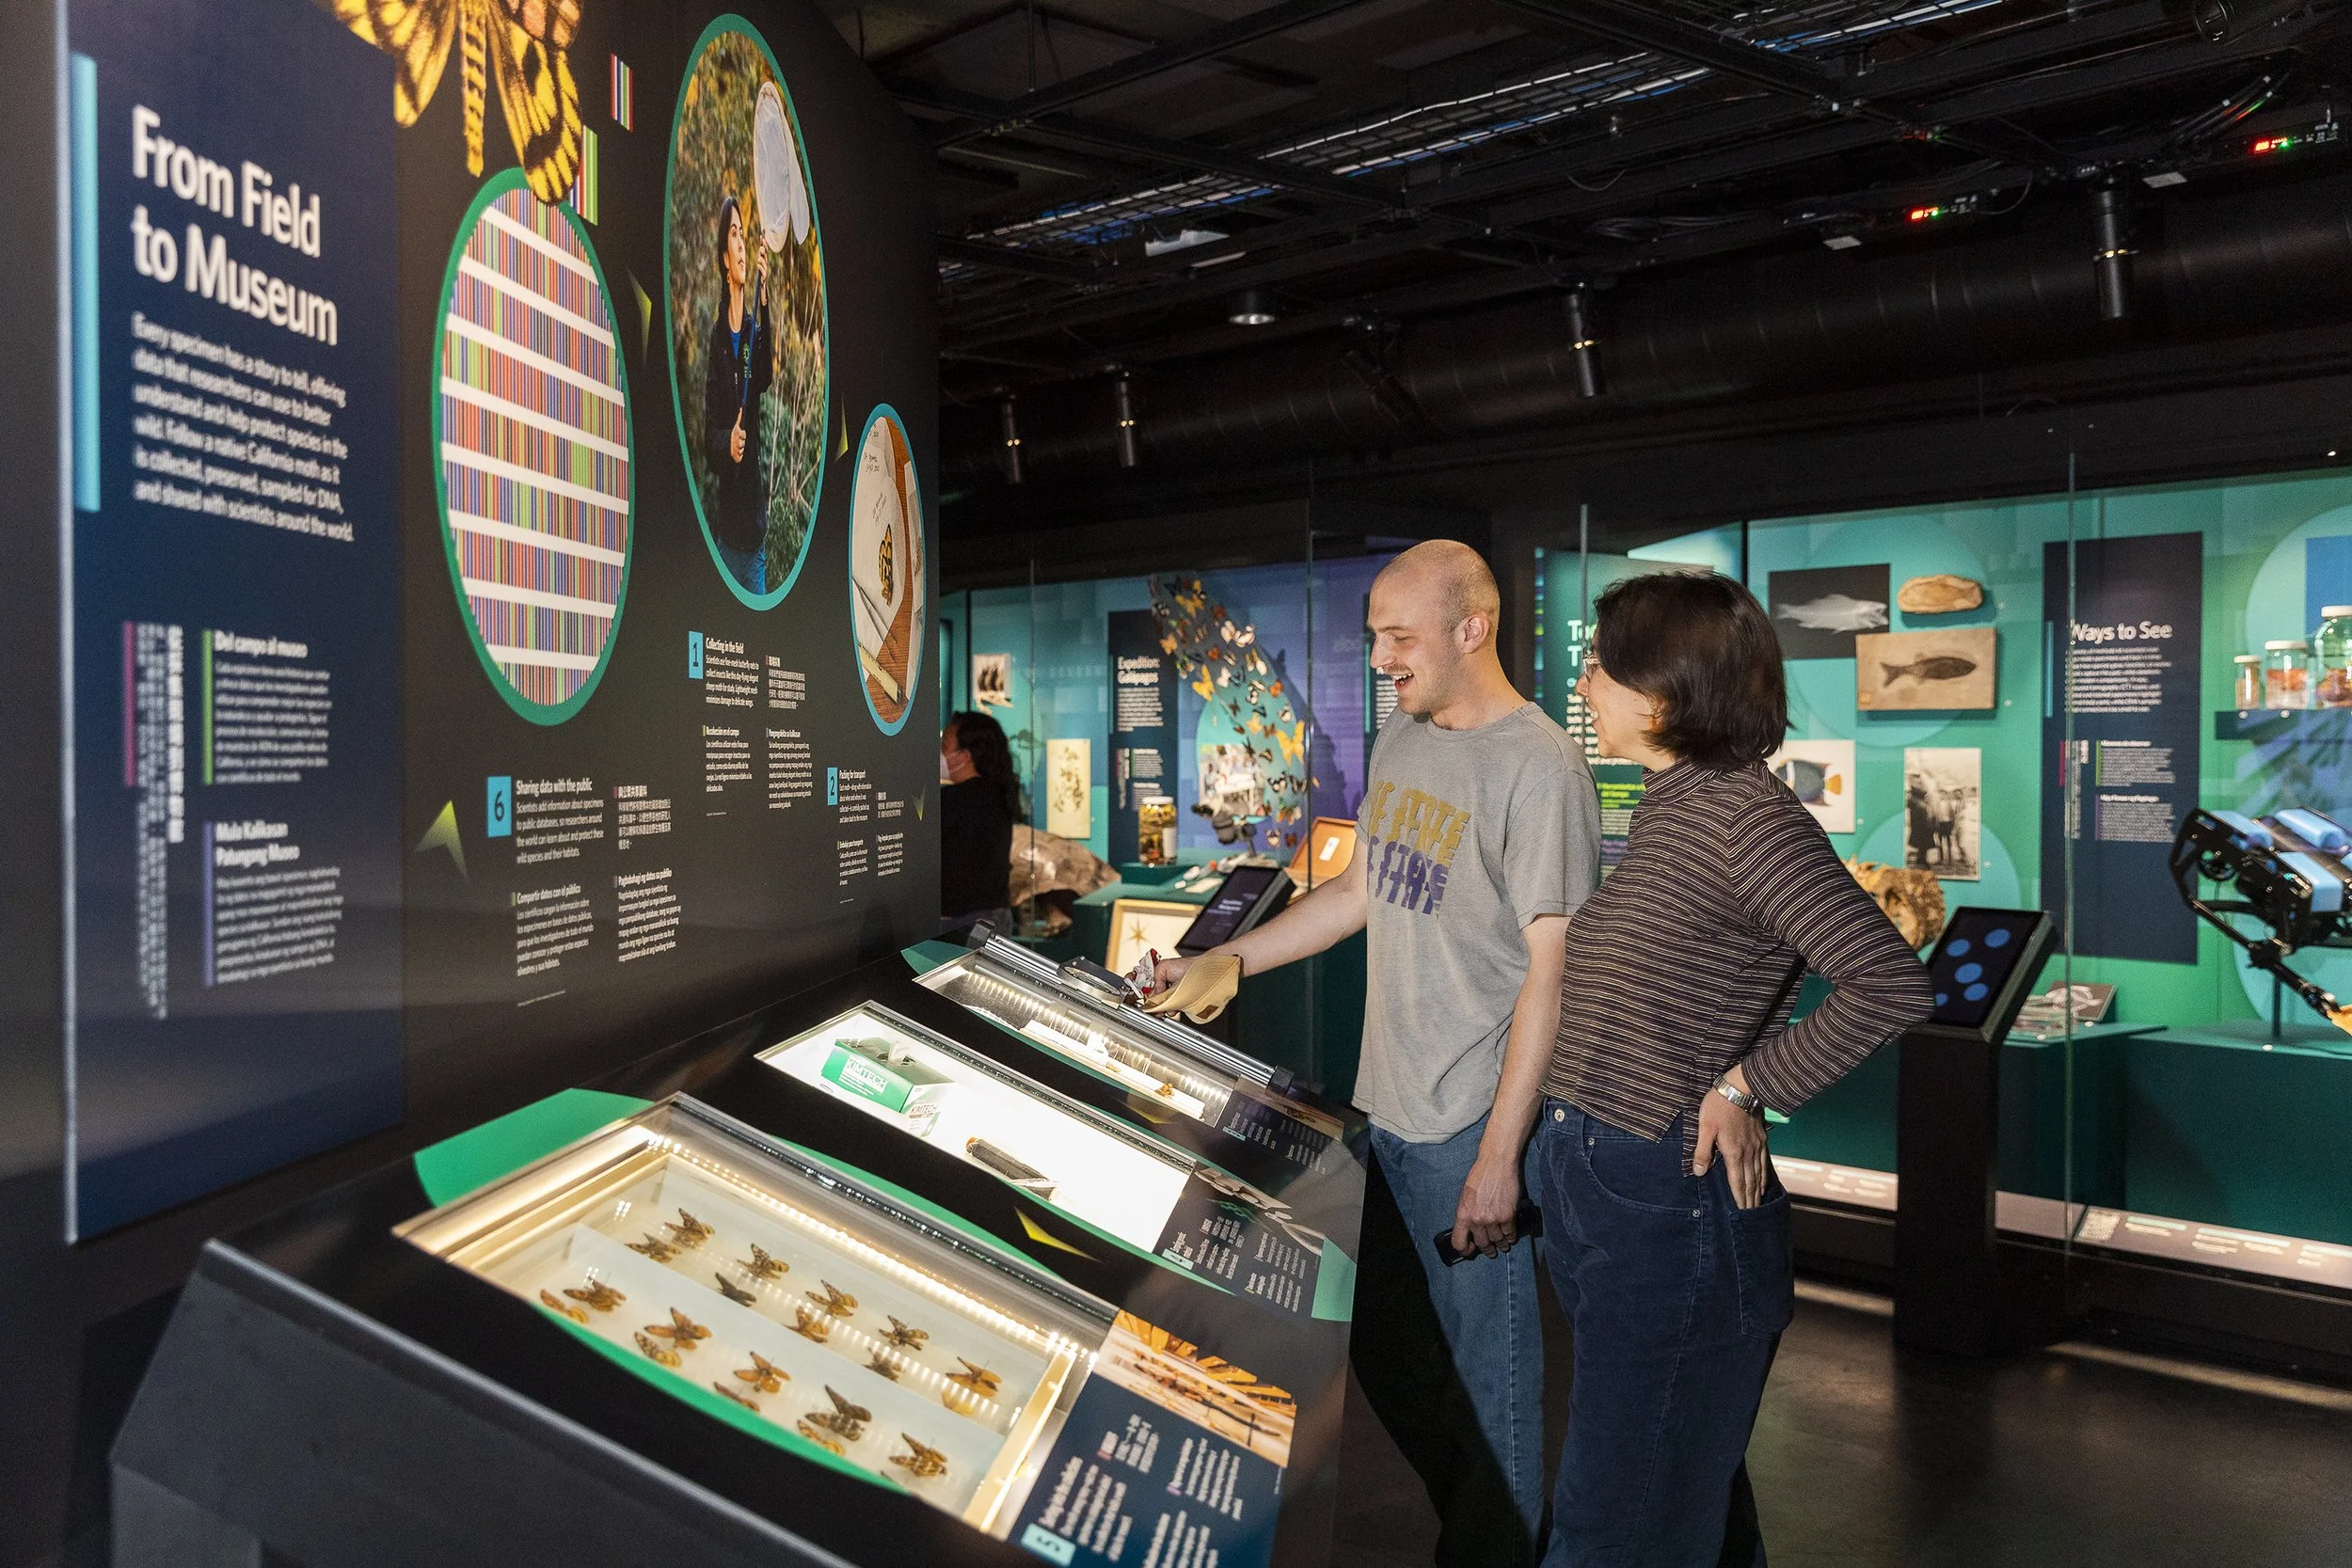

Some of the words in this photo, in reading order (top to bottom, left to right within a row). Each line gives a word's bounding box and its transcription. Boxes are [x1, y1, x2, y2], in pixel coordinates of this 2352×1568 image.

[132, 103, 234, 218] From
[241, 160, 321, 259] Field
[130, 203, 179, 283] to
[185, 223, 339, 346] Museum
[133, 312, 168, 351] Every
[170, 331, 225, 365] specimen
[226, 344, 243, 371] has
[245, 356, 254, 374] a
[255, 358, 279, 388] story
[280, 366, 293, 388] to
[294, 371, 310, 391] tell,
[310, 376, 346, 409] offering
[134, 344, 164, 376] data
[165, 356, 189, 384] that
[189, 369, 252, 404] researchers
[253, 389, 273, 410] can
[274, 395, 291, 415] use
[292, 399, 303, 419] to
[304, 401, 331, 427] better
[135, 382, 203, 420] understand
[204, 403, 226, 425] and
[226, 404, 250, 436] help
[250, 418, 286, 442] protect
[287, 428, 321, 452] species
[322, 434, 332, 455] in
[333, 438, 348, 459] the
[166, 418, 203, 450] Follow
[204, 435, 214, 452] a
[215, 436, 247, 461] native
[248, 441, 294, 473] California
[294, 459, 320, 480] moth
[321, 467, 332, 483] as
[333, 465, 340, 485] it
[135, 442, 150, 468] is
[261, 480, 302, 505] sampled
[304, 486, 318, 509] for
[318, 490, 343, 514] DNA,
[135, 479, 162, 503] and
[163, 483, 201, 512] shared
[203, 492, 228, 517] with
[228, 499, 275, 527] scientists
[276, 512, 310, 534] around
[311, 516, 326, 538] the
[2117, 623, 2137, 640] to
[2139, 621, 2173, 640] See
[692, 642, 699, 667] 1
[707, 638, 724, 654] Collecting
[725, 641, 728, 652] in
[516, 780, 539, 797] Sharing
[540, 779, 552, 794] data
[554, 778, 565, 793] with
[566, 777, 576, 792] the
[577, 776, 592, 794] public
[830, 776, 834, 796] 2
[494, 790, 505, 822] 6
[516, 801, 537, 814] Scientists
[548, 800, 571, 811] information
[572, 799, 582, 809] about
[584, 797, 604, 810] specimens
[517, 820, 521, 830] to
[523, 818, 535, 832] public
[537, 816, 558, 828] databases,
[565, 814, 588, 826] researchers
[589, 812, 602, 823] around
[526, 834, 537, 846] world
[548, 833, 557, 843] learn
[559, 832, 570, 842] about
[579, 829, 593, 842] protect
[594, 828, 604, 838] these
[517, 852, 527, 863] wild
[528, 850, 543, 863] species
[553, 847, 562, 859] their
[564, 846, 580, 857] habitats.
[847, 1059, 888, 1089] KIMTECH
[911, 1103, 938, 1115] KIMTECH
[1035, 1537, 1061, 1552] 5
